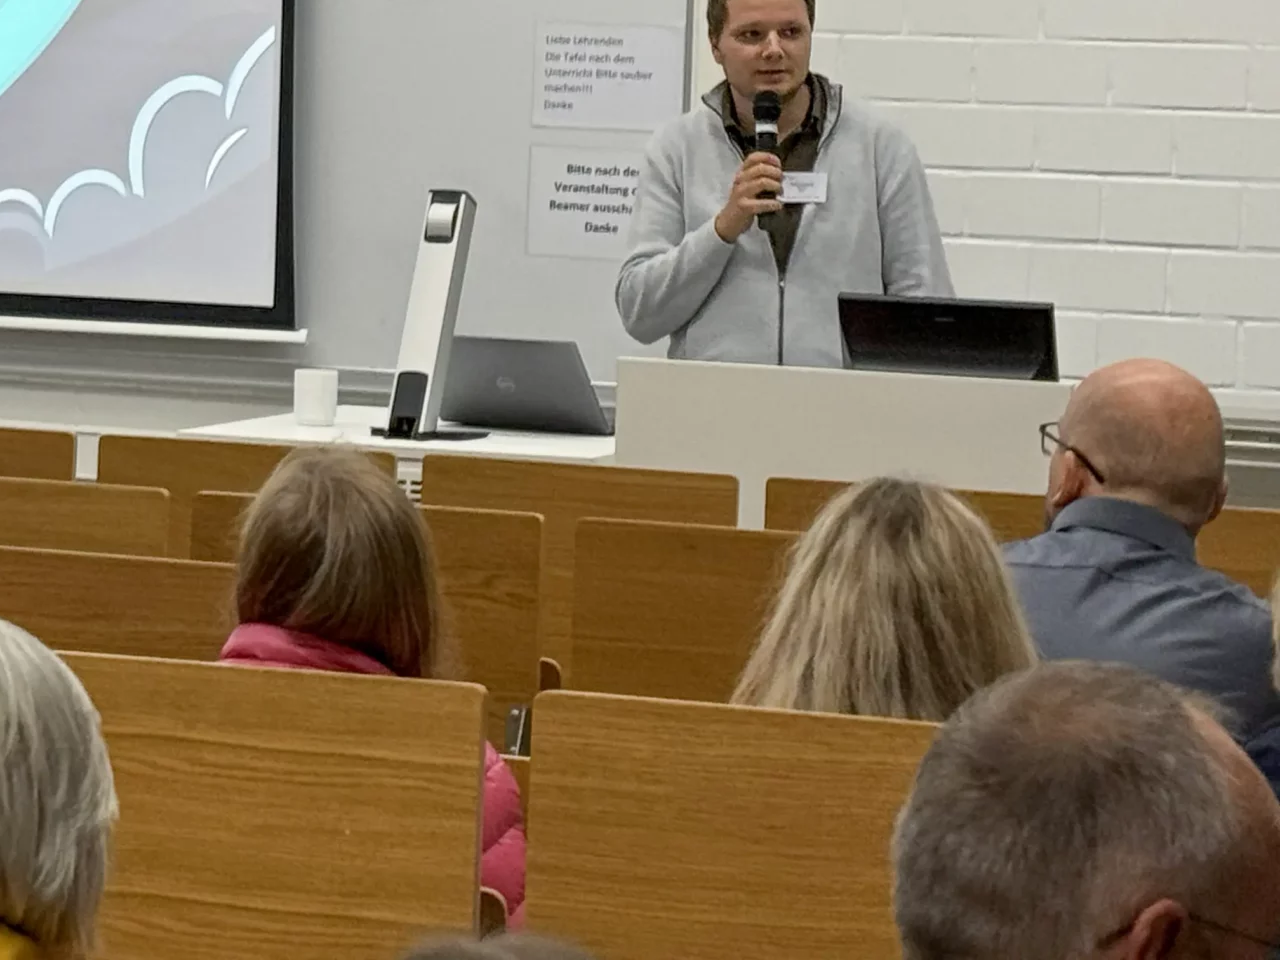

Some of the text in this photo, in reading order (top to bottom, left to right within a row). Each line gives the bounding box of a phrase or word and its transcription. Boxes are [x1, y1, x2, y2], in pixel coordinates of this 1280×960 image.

[546, 35, 571, 45] Liebe
[545, 52, 635, 65] Die Tafel nach dem
[544, 68, 653, 80] Unterricht Bitte sauber
[544, 100, 573, 110] Danke
[567, 164, 592, 176] Bitte
[595, 165, 620, 177] nach
[554, 181, 629, 197] Veranstaltung
[549, 200, 590, 212] Beamer
[585, 221, 619, 233] Danke
